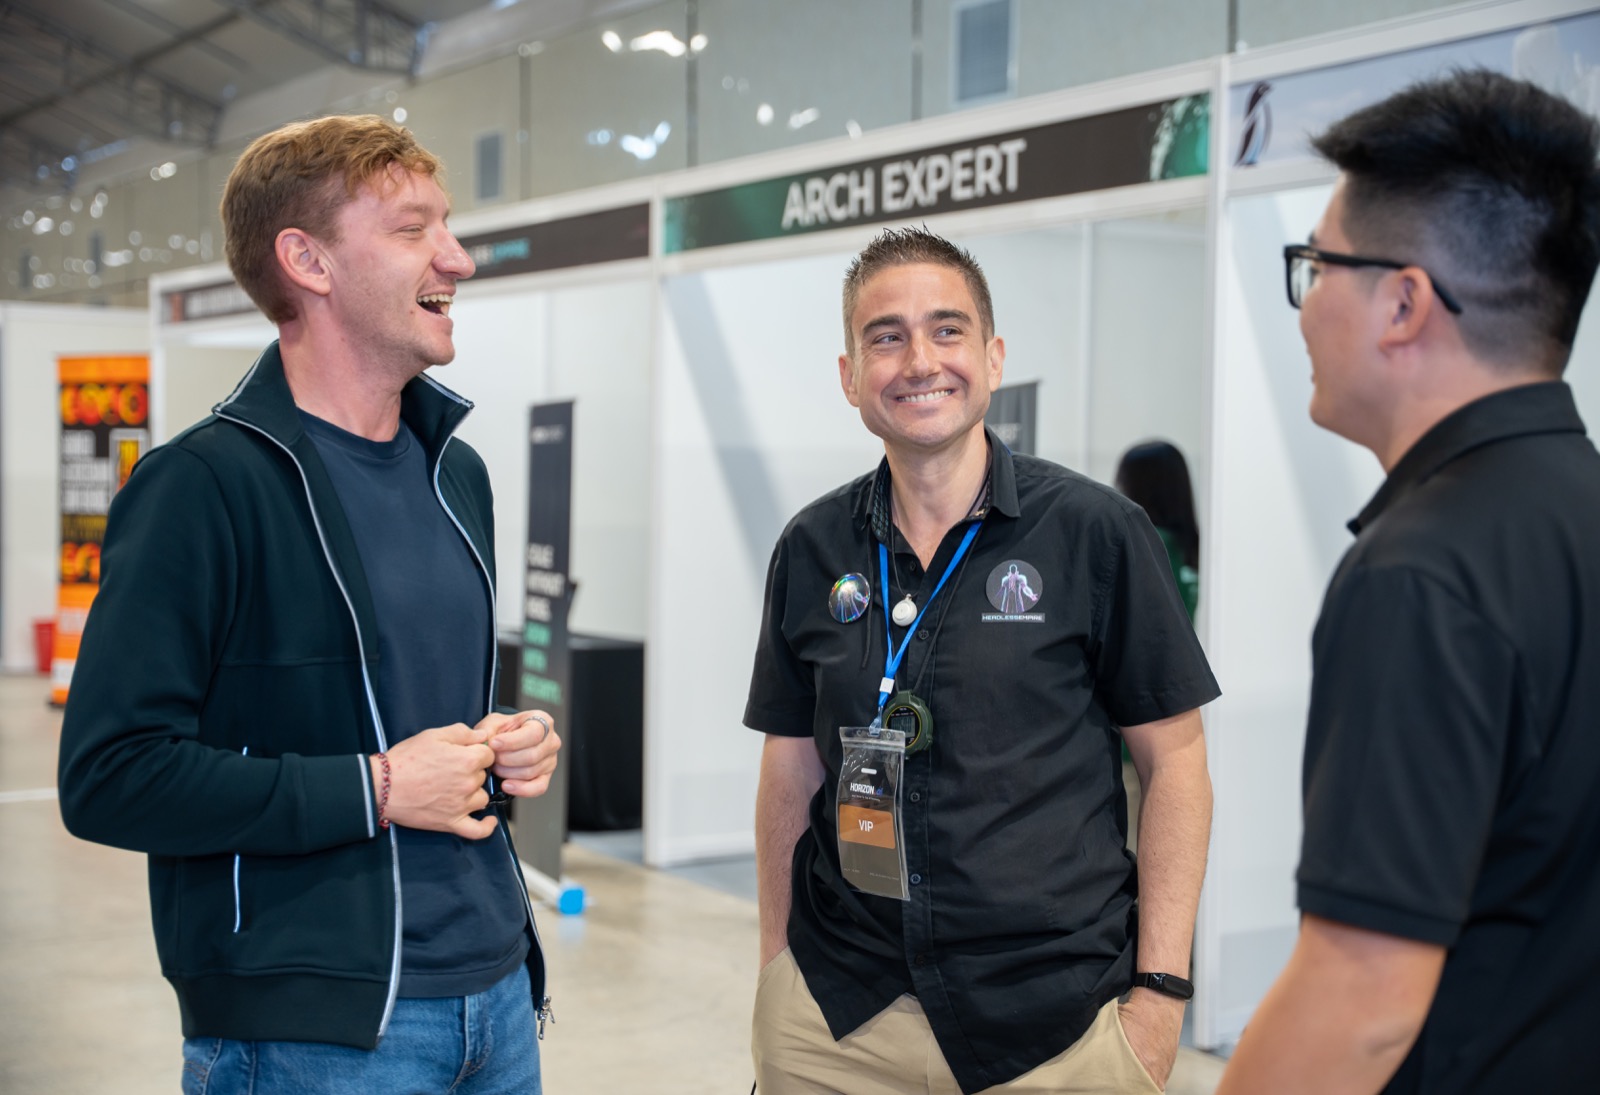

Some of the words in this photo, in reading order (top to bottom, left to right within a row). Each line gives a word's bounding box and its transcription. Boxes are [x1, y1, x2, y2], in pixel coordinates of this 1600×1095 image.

[781, 167, 875, 230] ARCH
[881, 138, 1027, 213] EXPERT
[858, 819, 874, 832] VIP
